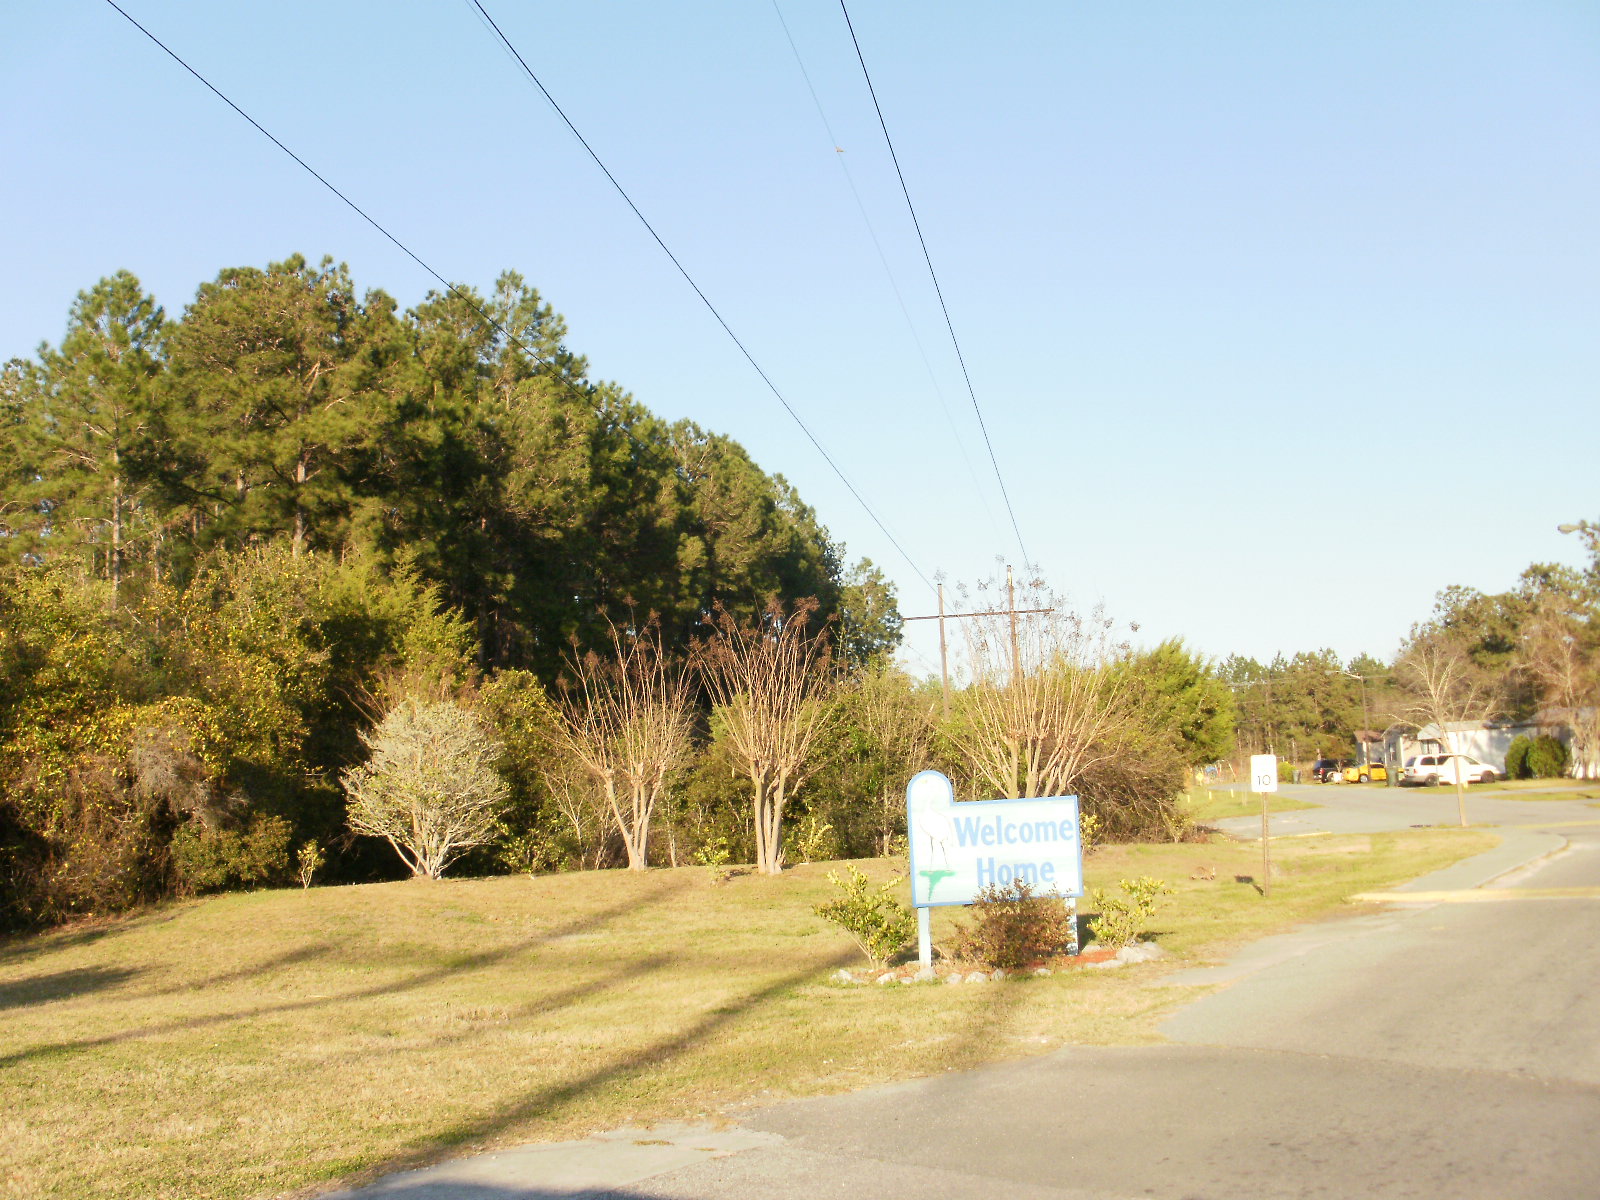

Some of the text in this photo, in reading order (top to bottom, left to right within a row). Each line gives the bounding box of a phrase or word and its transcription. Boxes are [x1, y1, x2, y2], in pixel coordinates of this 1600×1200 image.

[1257, 774, 1271, 786] 10
[953, 815, 1074, 847] Welcome
[976, 857, 1055, 887] Home
